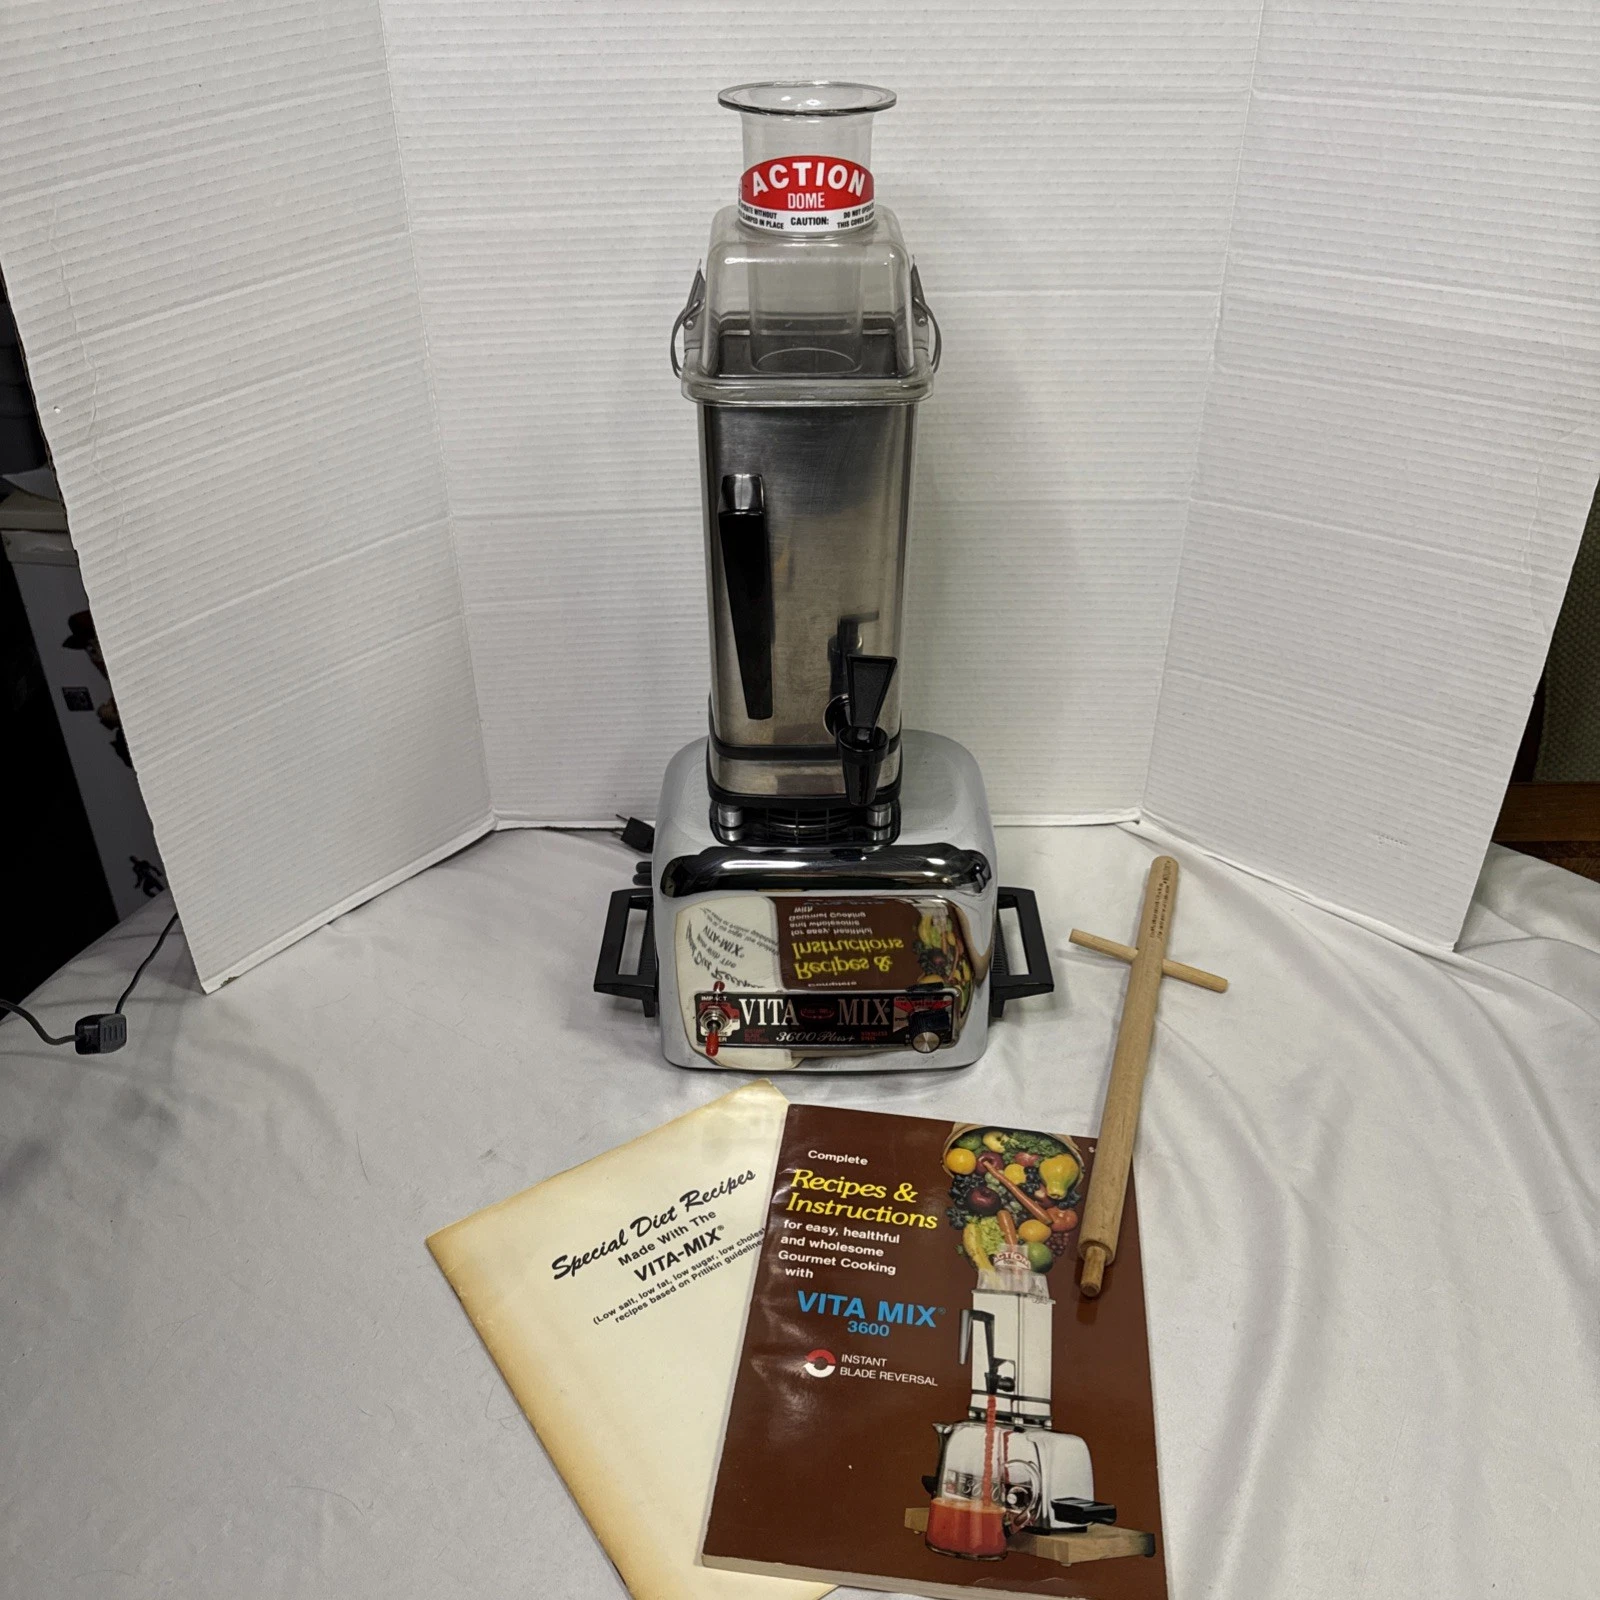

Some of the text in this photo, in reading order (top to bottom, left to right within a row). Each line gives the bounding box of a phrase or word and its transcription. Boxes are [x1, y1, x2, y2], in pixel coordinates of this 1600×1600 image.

[752, 161, 865, 197] ACTION
[787, 192, 825, 209] DOME
[755, 208, 777, 219] WITHOUT
[790, 216, 829, 226] CAUTION:
[837, 220, 849, 228] THIS
[851, 216, 864, 226] COVER
[843, 211, 850, 219] DO
[852, 208, 861, 217] NOT
[766, 220, 784, 229] PLACE
[738, 998, 800, 1026] VITA
[837, 998, 890, 1026] MIX
[775, 1031, 816, 1042] 3600
[807, 1150, 869, 1166] Complete
[790, 1168, 919, 1203] Recipes &
[786, 1192, 938, 1230] Instructions
[551, 1169, 756, 1280] Special Diet Recipes
[783, 1219, 900, 1244] for easy, healthful
[617, 1210, 717, 1266] Made With The
[780, 1235, 885, 1257] and wholesome
[778, 1250, 897, 1276] Gourmet Cooking
[785, 1266, 814, 1279] with
[592, 1307, 617, 1326] (Low
[618, 1296, 639, 1312] salt,
[638, 1286, 656, 1300] low
[656, 1276, 673, 1290] fat,
[673, 1268, 690, 1283] low
[690, 1254, 719, 1273] sugar,
[718, 1243, 735, 1256] low
[615, 1238, 764, 1324] recipes based on Pritikin guideline
[797, 1290, 938, 1328] VITA MIX
[847, 1320, 890, 1337] 3600
[841, 1353, 888, 1367] INSTANT
[840, 1366, 938, 1387] BLADE REVERSAL
